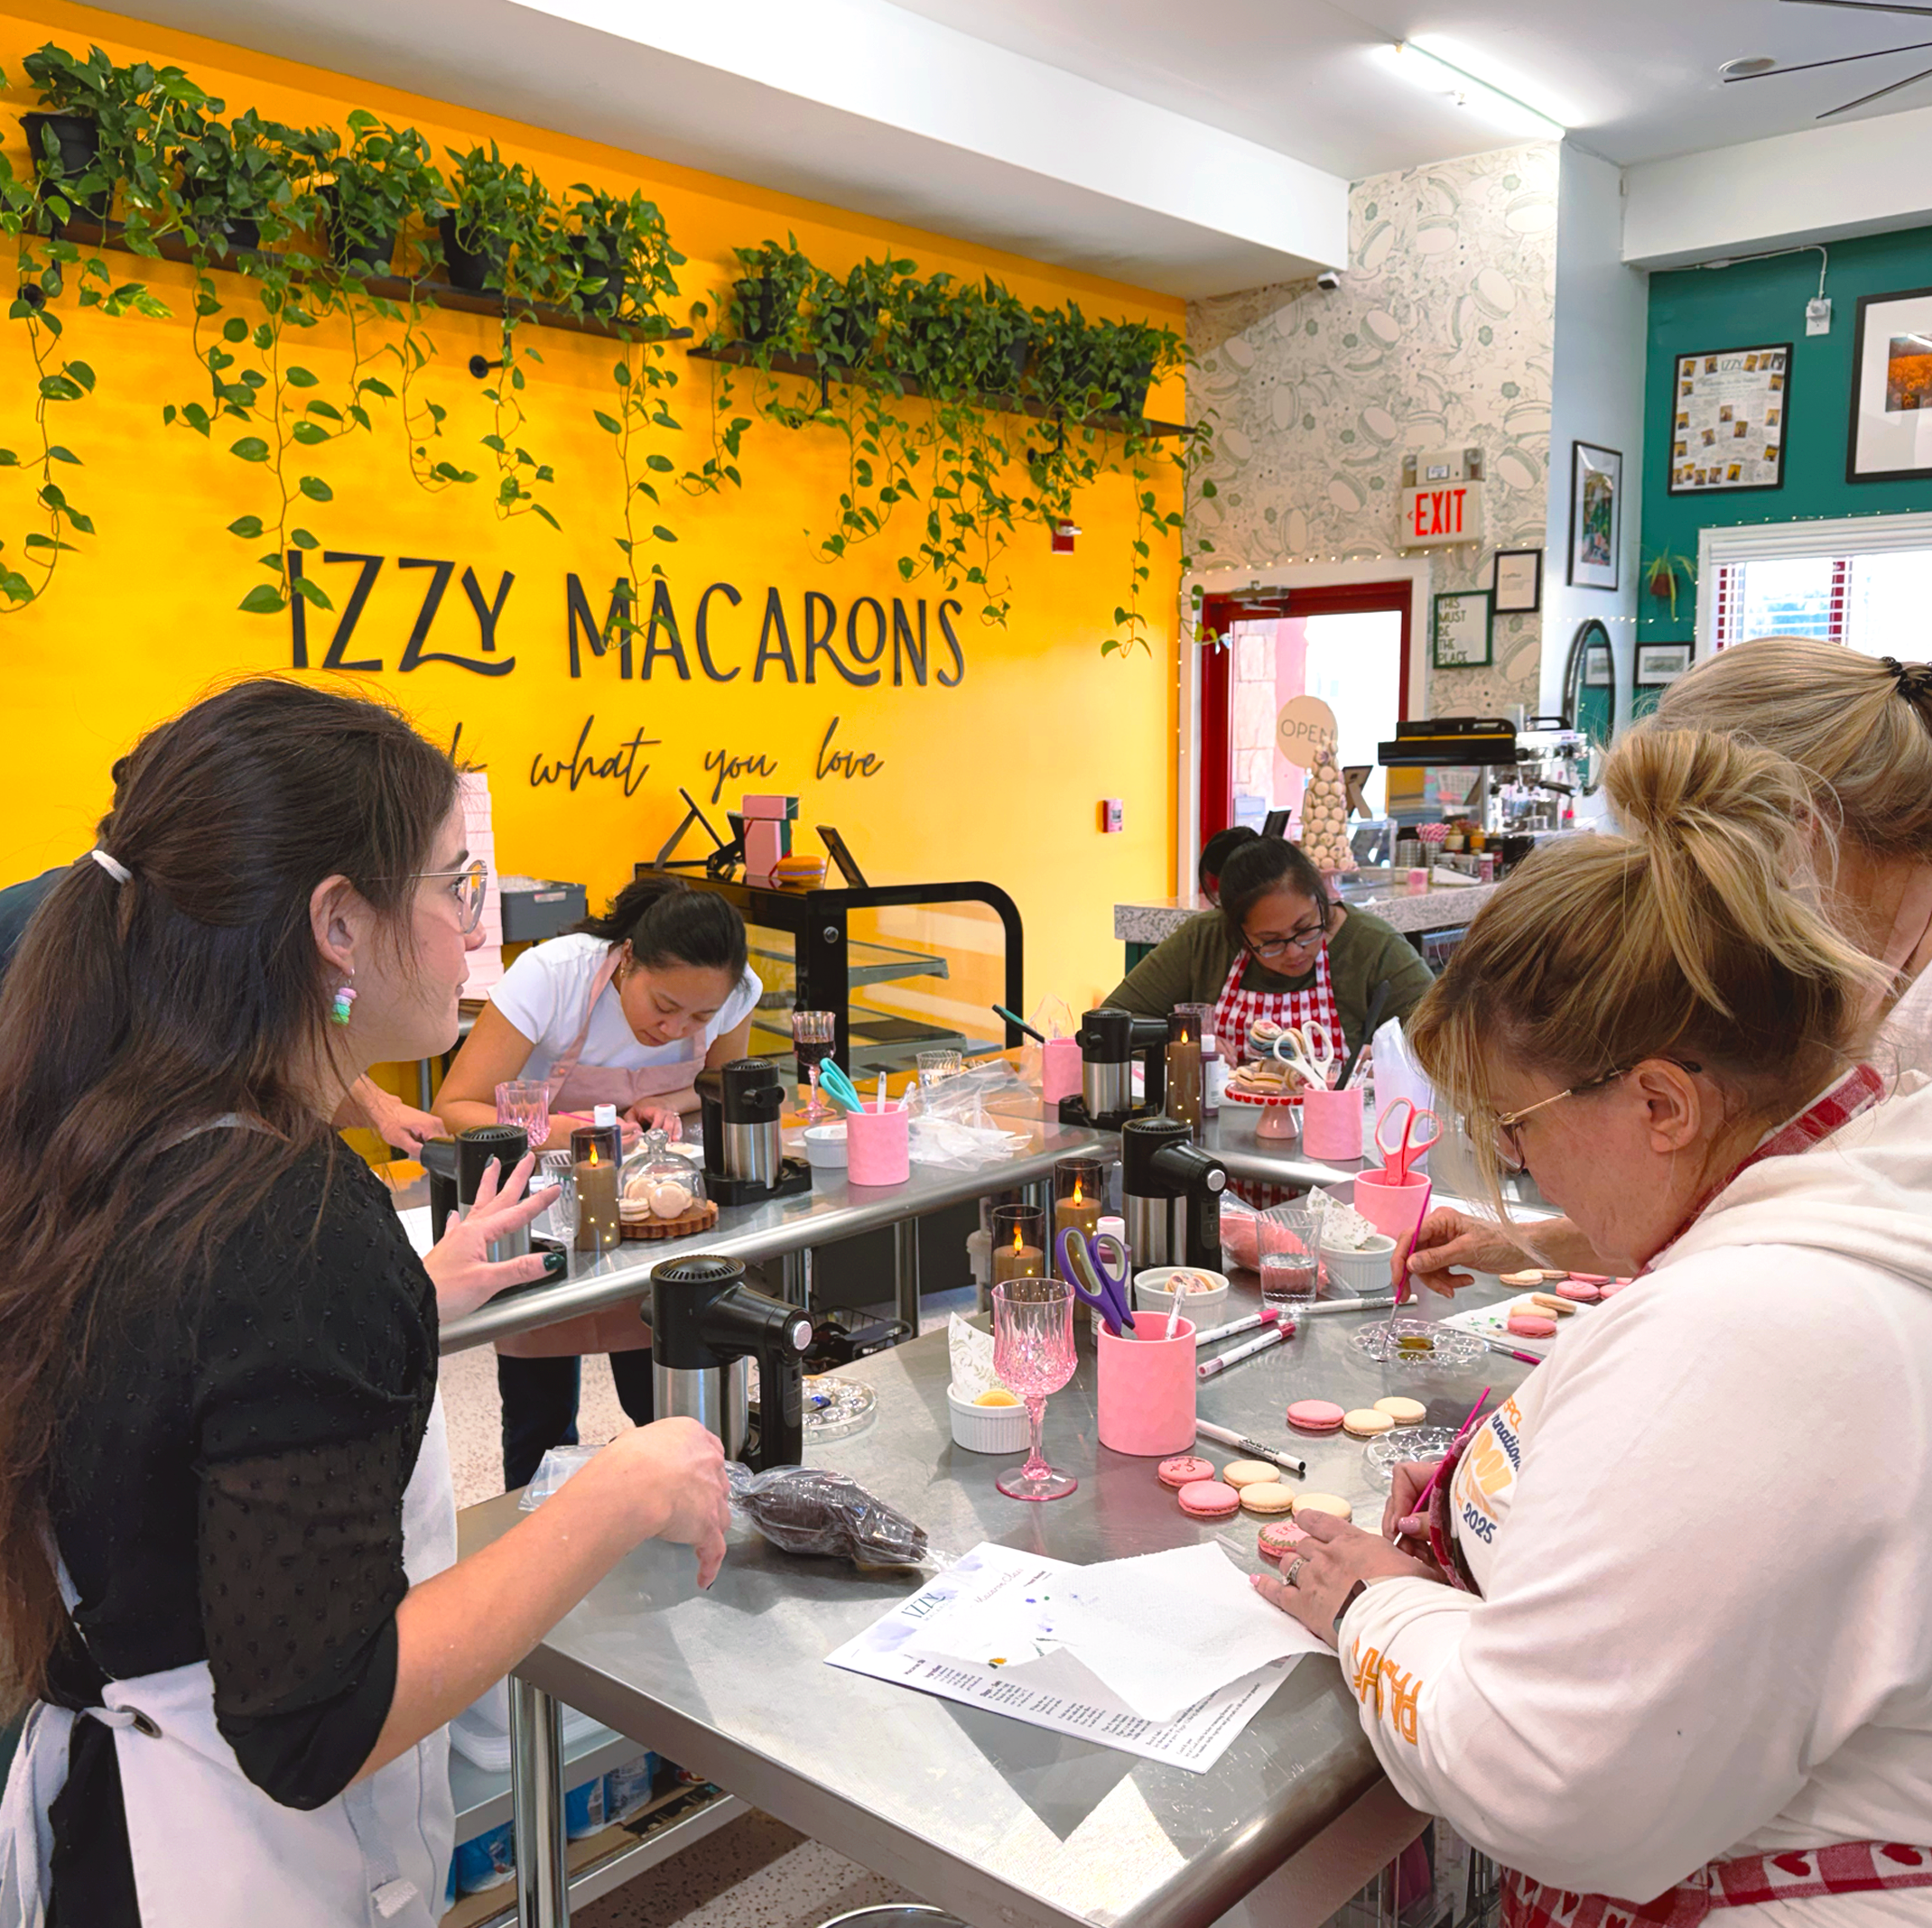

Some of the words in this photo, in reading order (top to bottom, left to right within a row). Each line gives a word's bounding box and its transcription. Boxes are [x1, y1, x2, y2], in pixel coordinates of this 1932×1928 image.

[1415, 488, 1466, 536] EXIT
[1438, 596, 1461, 609] THIS
[287, 550, 516, 676] IZZY
[566, 572, 964, 688] MACARONS
[1437, 610, 1467, 623] MUST
[1437, 625, 1450, 636] BE
[1438, 638, 1455, 650] THE
[1437, 651, 1468, 664] PLACE
[530, 714, 662, 797] what
[704, 748, 778, 805] you
[816, 717, 885, 780] love
[1463, 1502, 1498, 1544] 2025
[901, 1592, 946, 1617] IZZY
